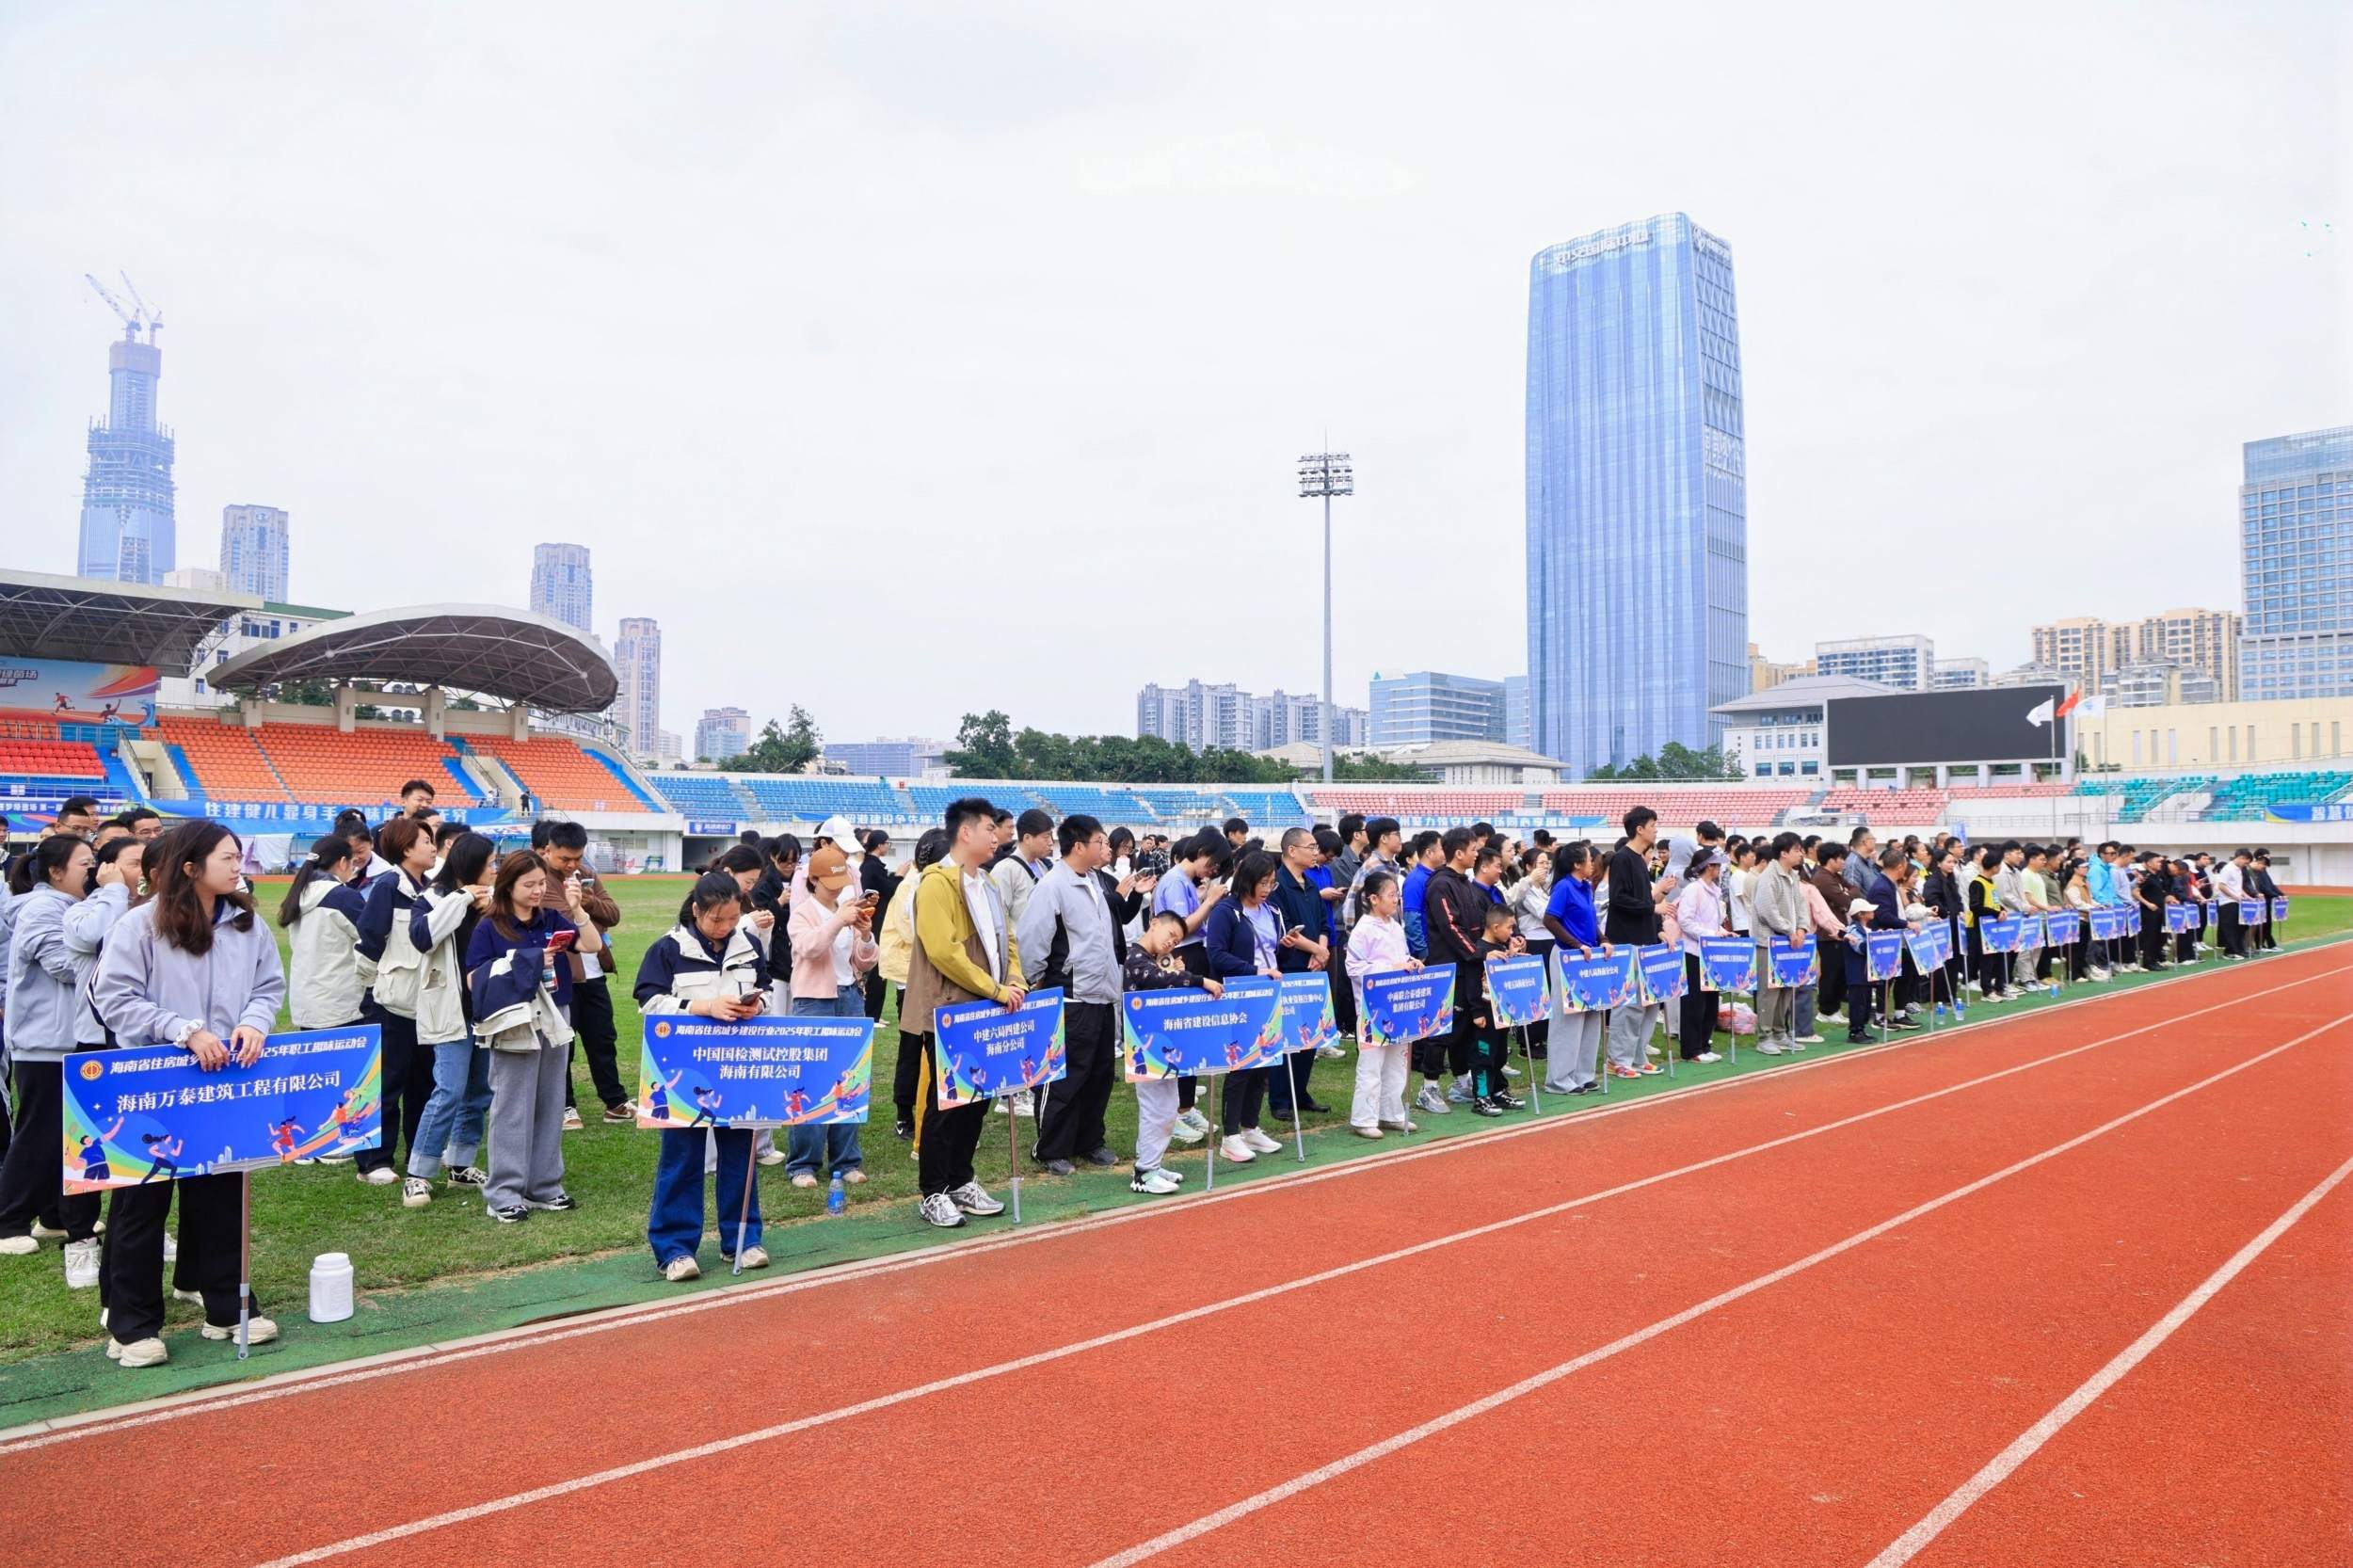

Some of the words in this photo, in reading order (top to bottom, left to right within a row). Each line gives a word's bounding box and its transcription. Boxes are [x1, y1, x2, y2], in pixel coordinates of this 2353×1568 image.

[204, 802, 337, 821] 住建健儿显身手
[675, 1024, 863, 1037] 海南省住房城乡建设行业2025年职工趣味运动会
[974, 1019, 1034, 1043] 中建六局四建公司
[1163, 1012, 1248, 1031] 海南省建设信息协会
[693, 1047, 828, 1062] 中国国检测试控股集团
[986, 1037, 1024, 1056] 海南分公司
[719, 1064, 801, 1080] 海南有限公司
[117, 1070, 341, 1114] 海南万泰建筑工程有限公司
